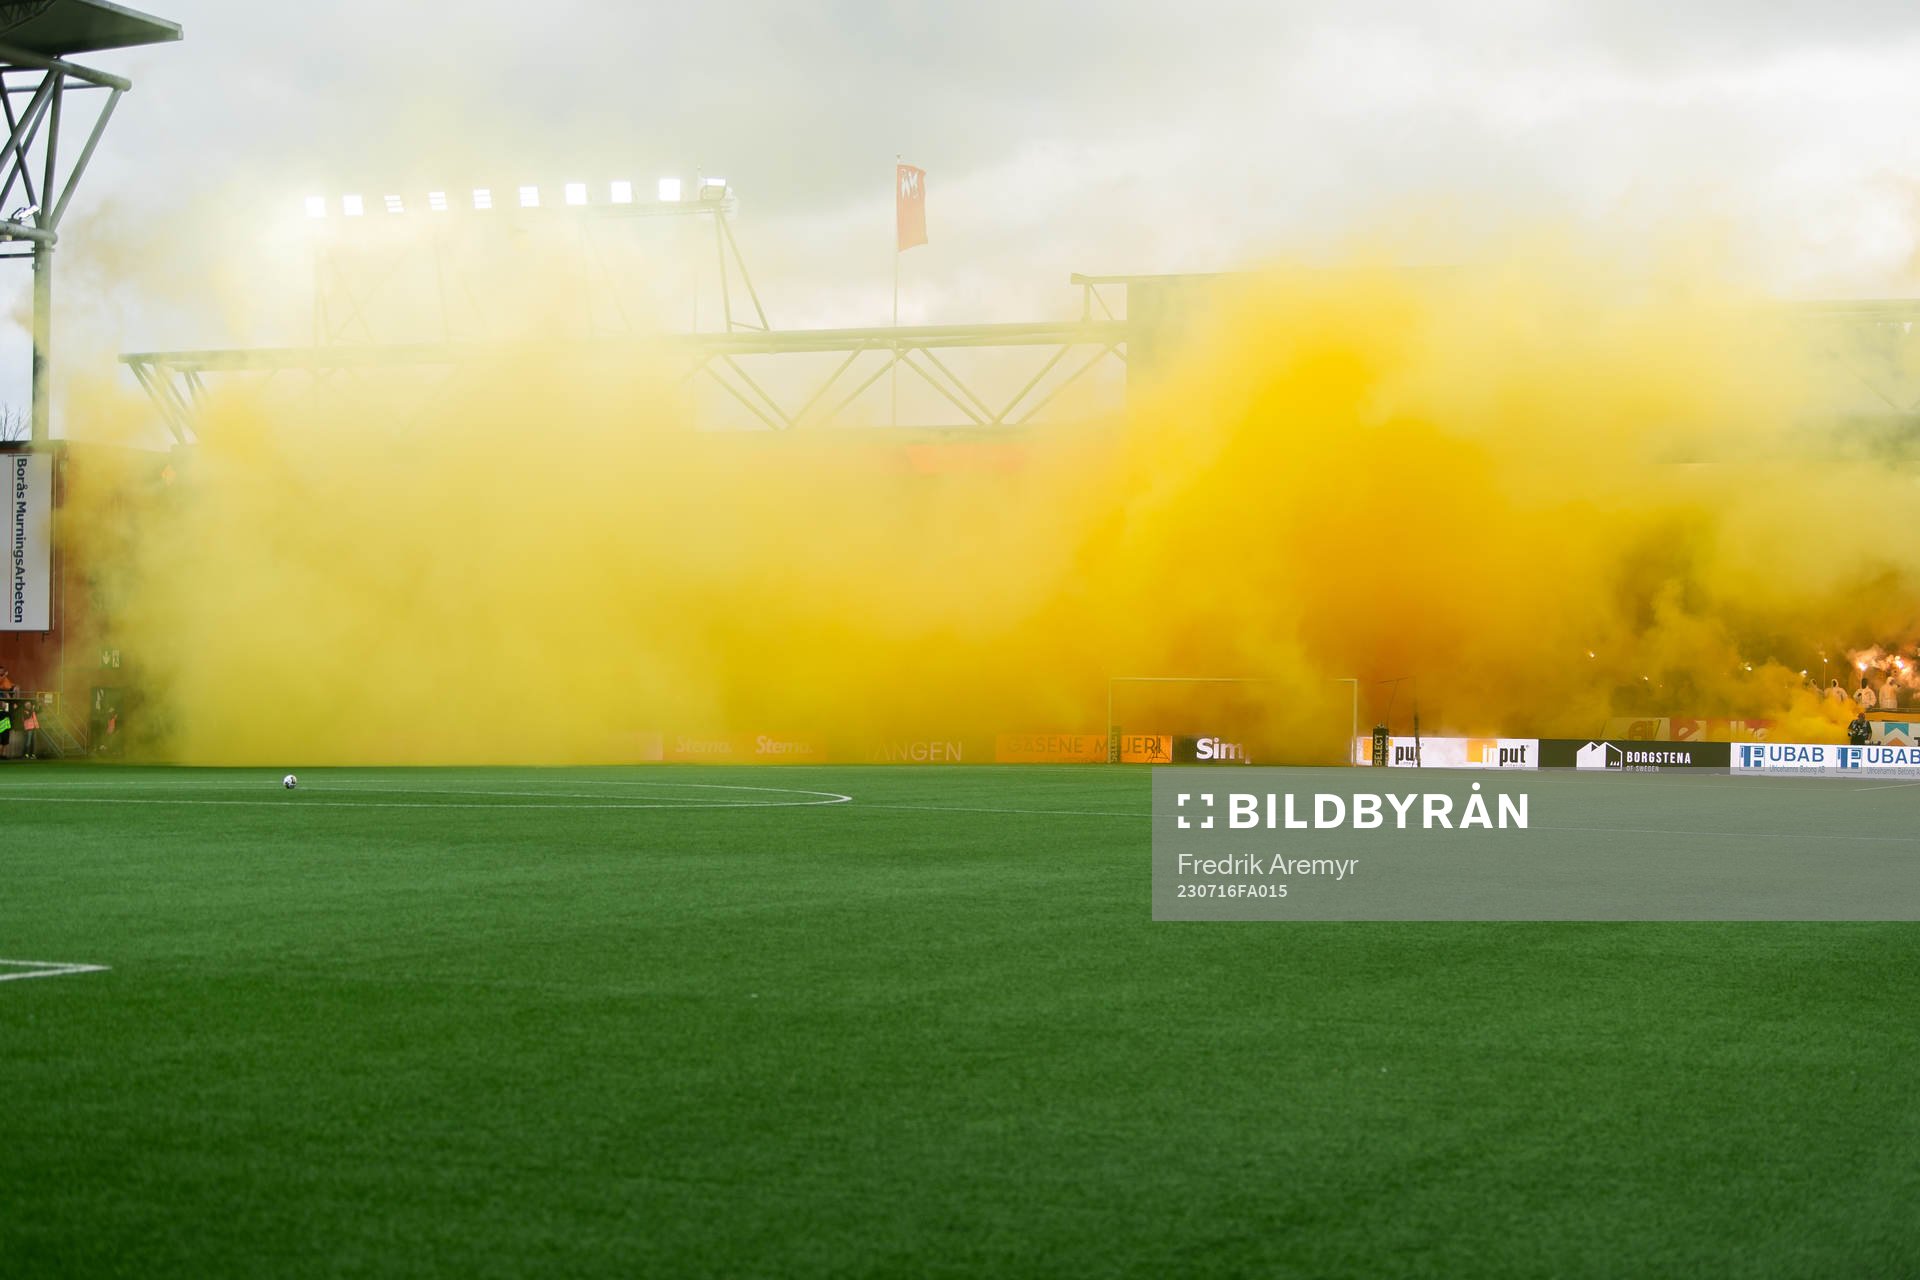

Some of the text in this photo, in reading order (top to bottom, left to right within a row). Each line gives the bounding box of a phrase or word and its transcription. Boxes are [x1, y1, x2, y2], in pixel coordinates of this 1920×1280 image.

[17, 458, 28, 499] Borås
[1196, 737, 1251, 764] Sim
[1374, 734, 1384, 766] SELECT
[1626, 751, 1691, 764] BORGSTENA
[1769, 746, 1825, 762] UBAB
[1867, 748, 1920, 764] UBAB
